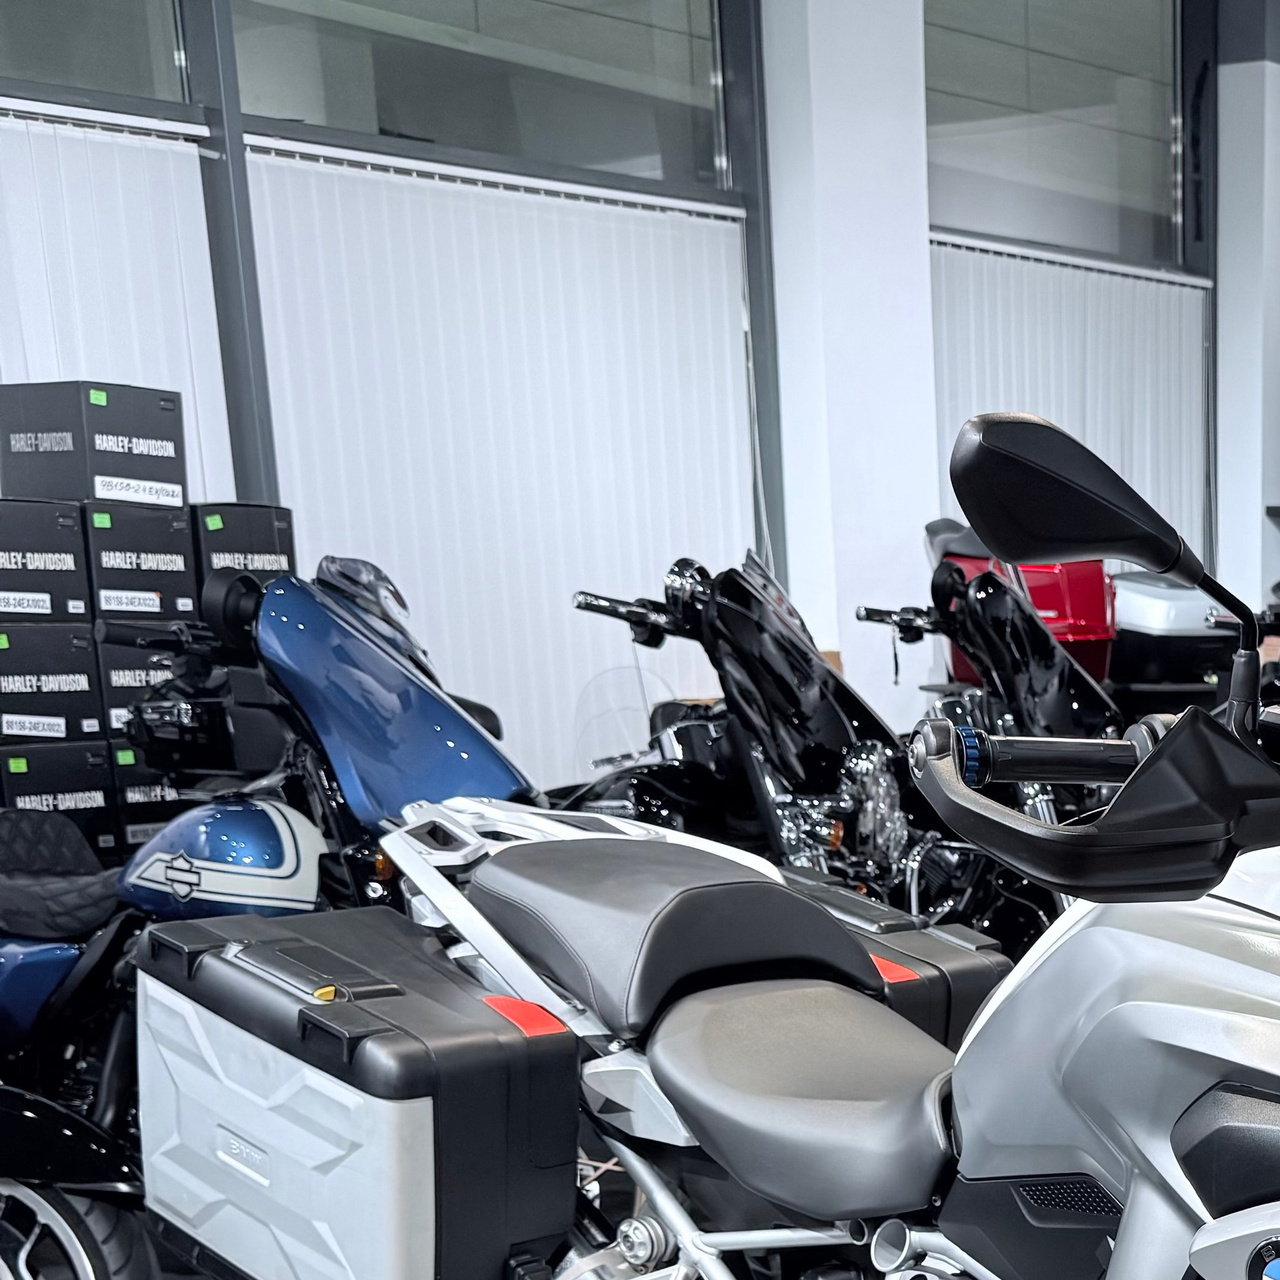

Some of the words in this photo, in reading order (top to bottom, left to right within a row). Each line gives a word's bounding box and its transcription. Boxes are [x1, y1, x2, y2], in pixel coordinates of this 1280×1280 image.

[10, 432, 74, 452] HARLEY-DAVIDSON
[94, 434, 176, 457] HARLEY-DAVIDSON
[0, 551, 76, 571] RLEY-DAVIDSON
[101, 551, 185, 571] HARLEY-DAVIDSON
[211, 552, 289, 571] HARLEY-DAVIDSON
[0, 674, 90, 693] HARLEY-DAVIDSON
[16, 790, 106, 811] HARLEY-DAVIDSON
